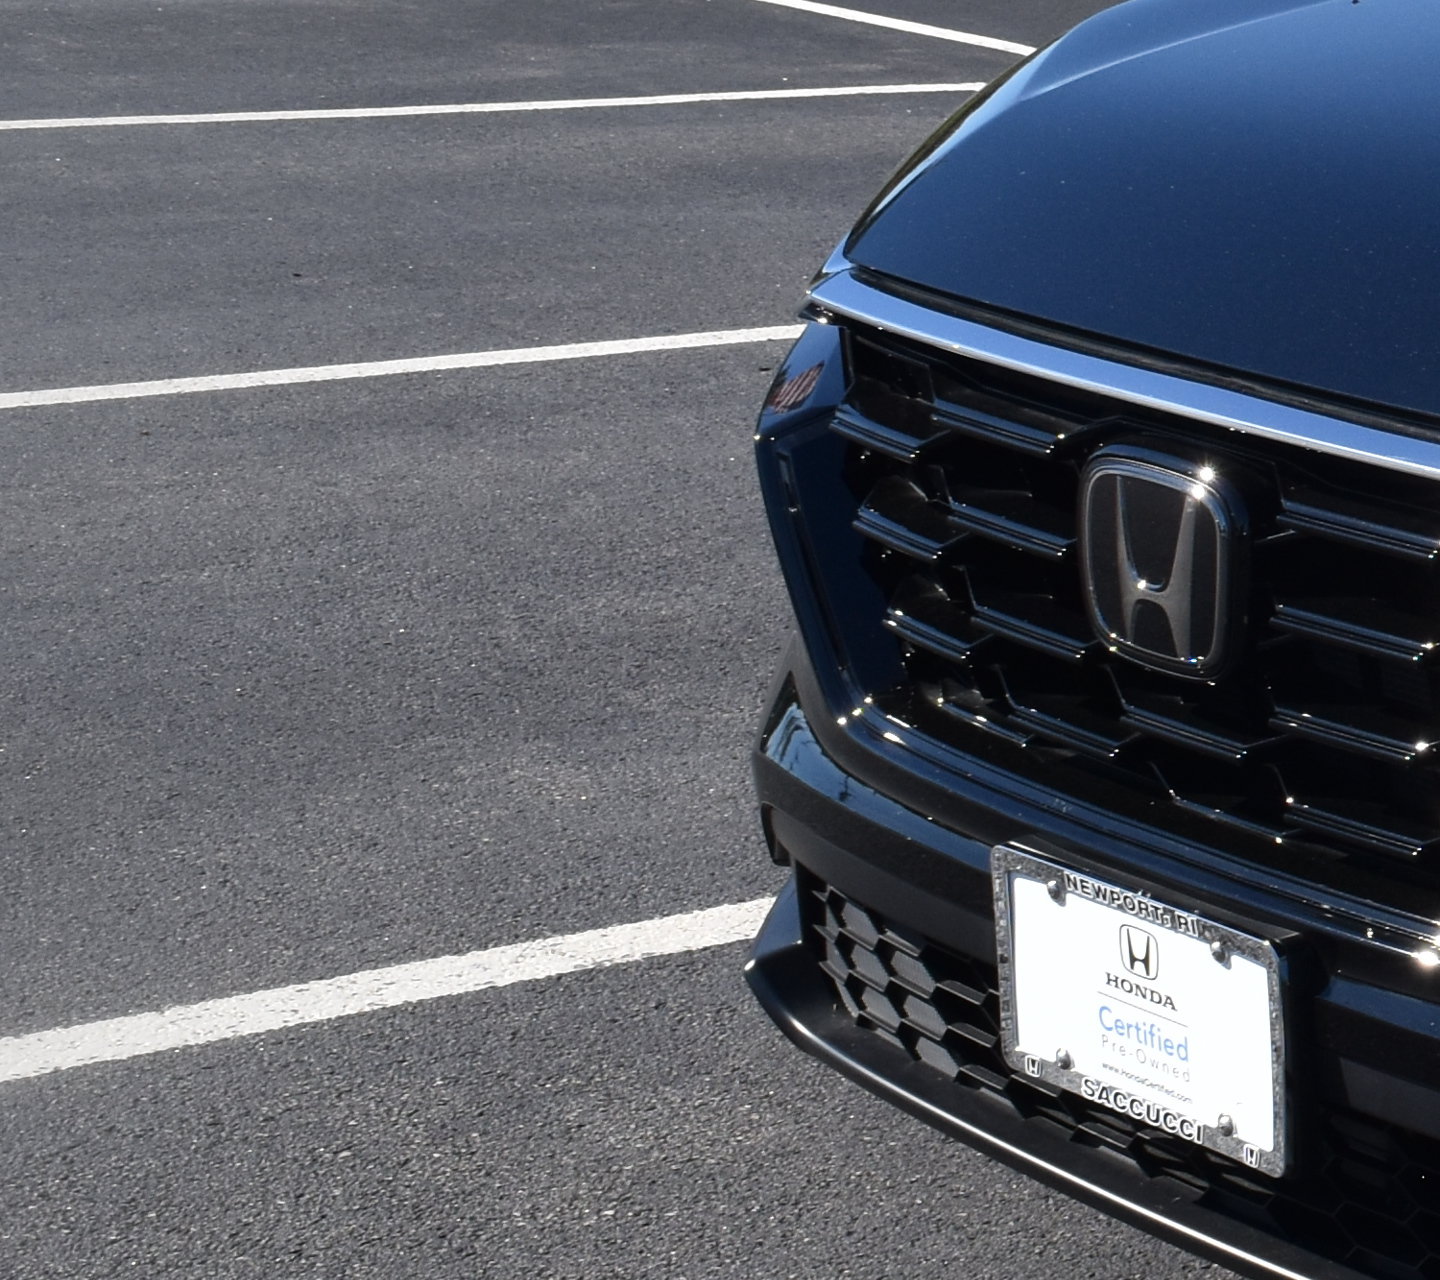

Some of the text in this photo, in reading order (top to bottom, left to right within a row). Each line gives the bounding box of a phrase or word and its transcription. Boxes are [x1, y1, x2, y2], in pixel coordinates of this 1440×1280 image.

[1175, 911, 1198, 936] RI
[1105, 972, 1178, 1012] HONDA
[1098, 1005, 1189, 1062] Certified
[1101, 1034, 1191, 1082] Pre-Owned
[1082, 1078, 1204, 1143] SACCUCCI
